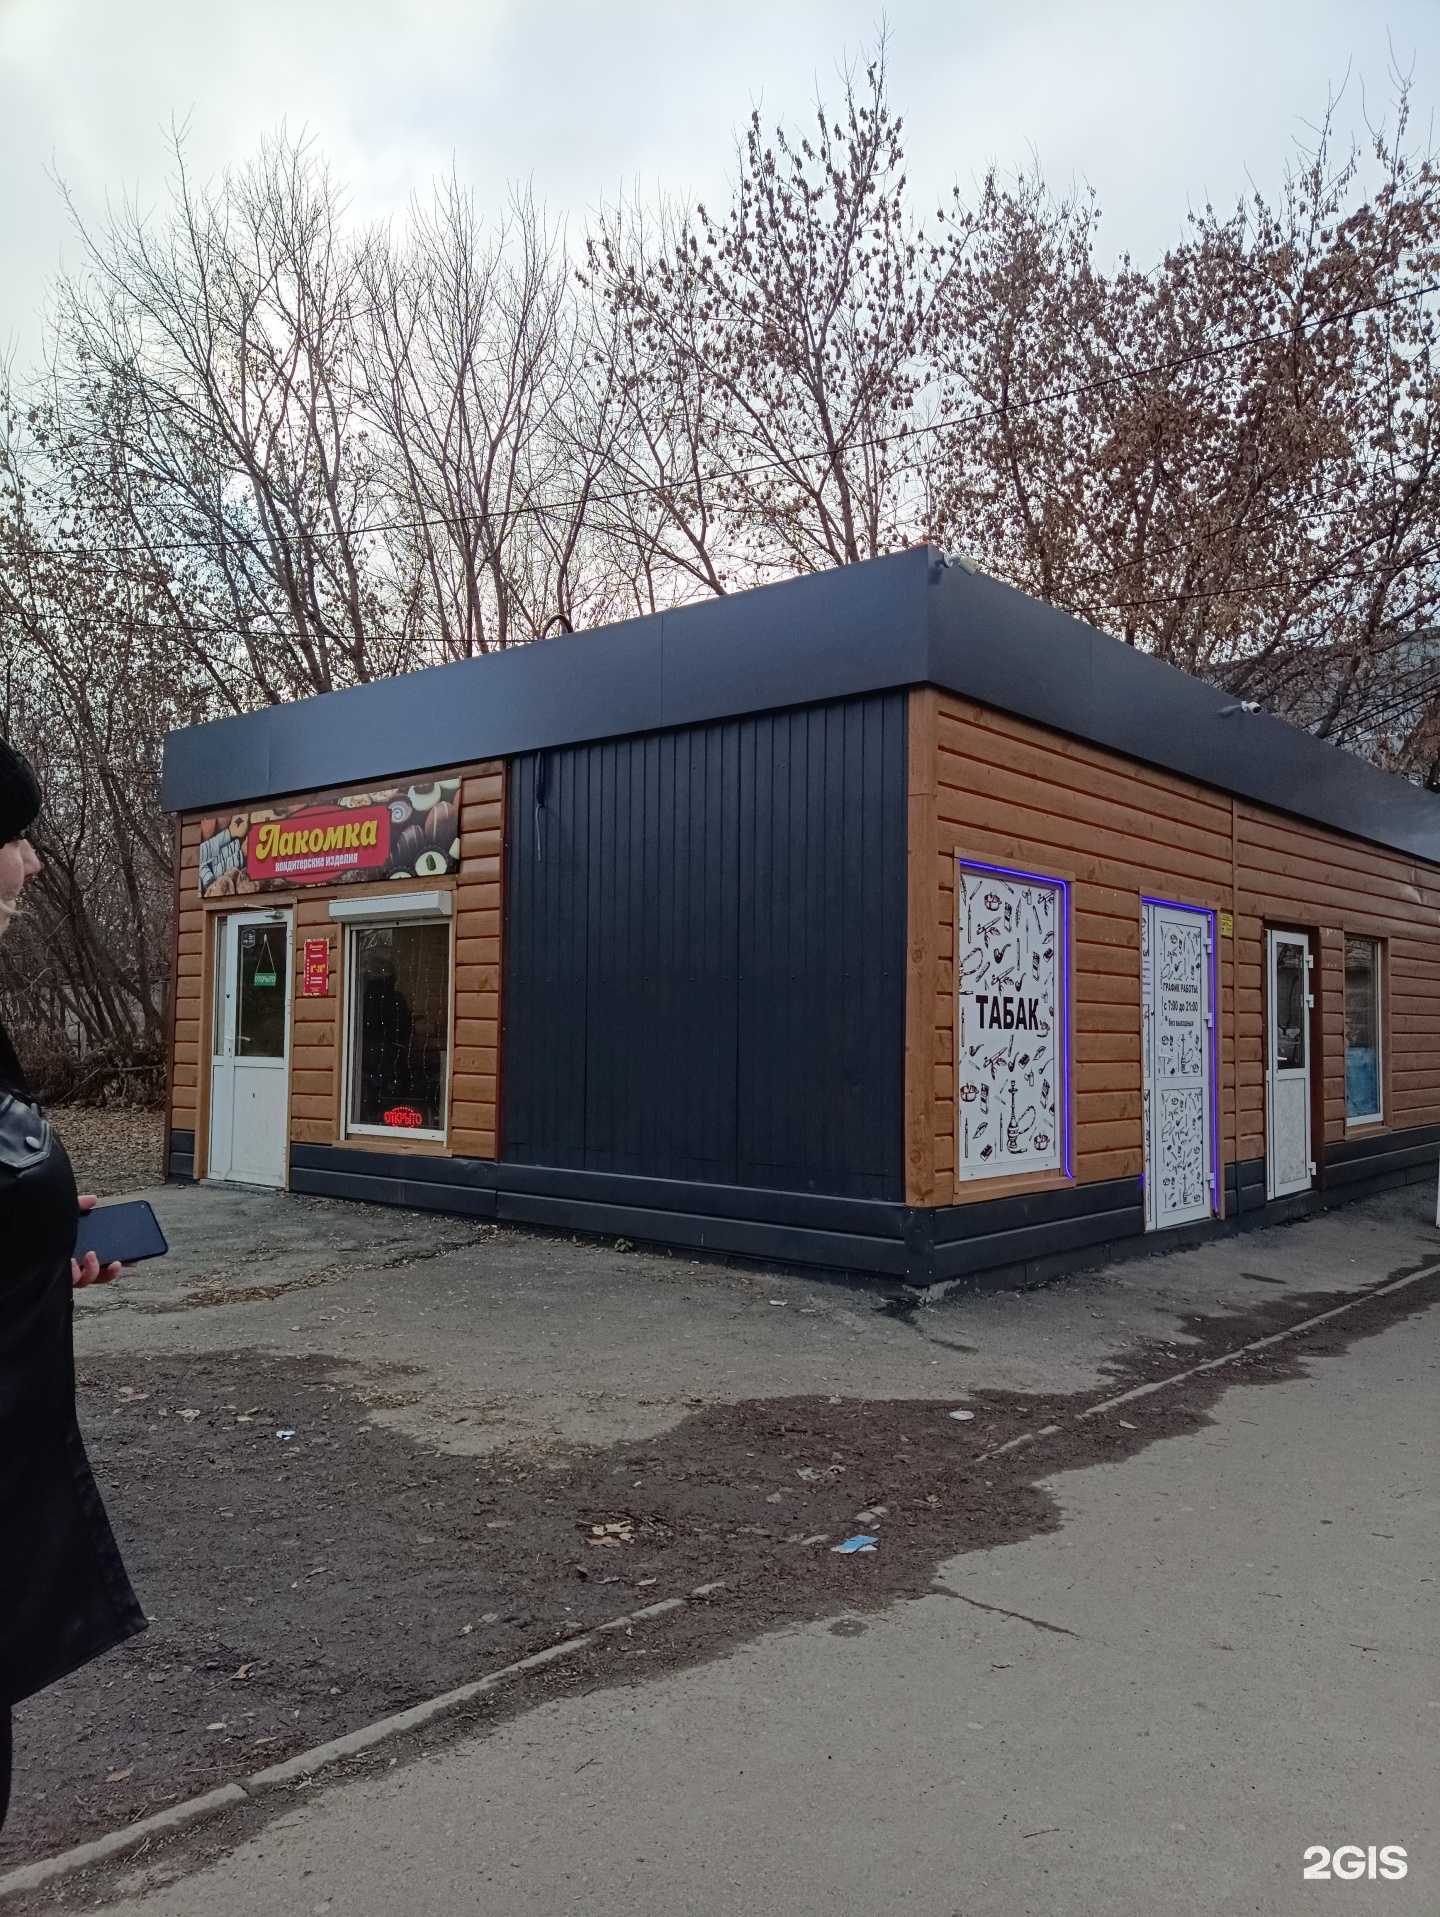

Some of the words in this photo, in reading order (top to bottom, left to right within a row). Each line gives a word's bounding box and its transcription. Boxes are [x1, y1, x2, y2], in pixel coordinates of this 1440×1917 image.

[256, 820, 377, 859] Лакомка
[1163, 983, 1180, 992] ГРАФИК
[976, 995, 1039, 1030] ТАБАК
[384, 1111, 422, 1126] ОТКРЫТО
